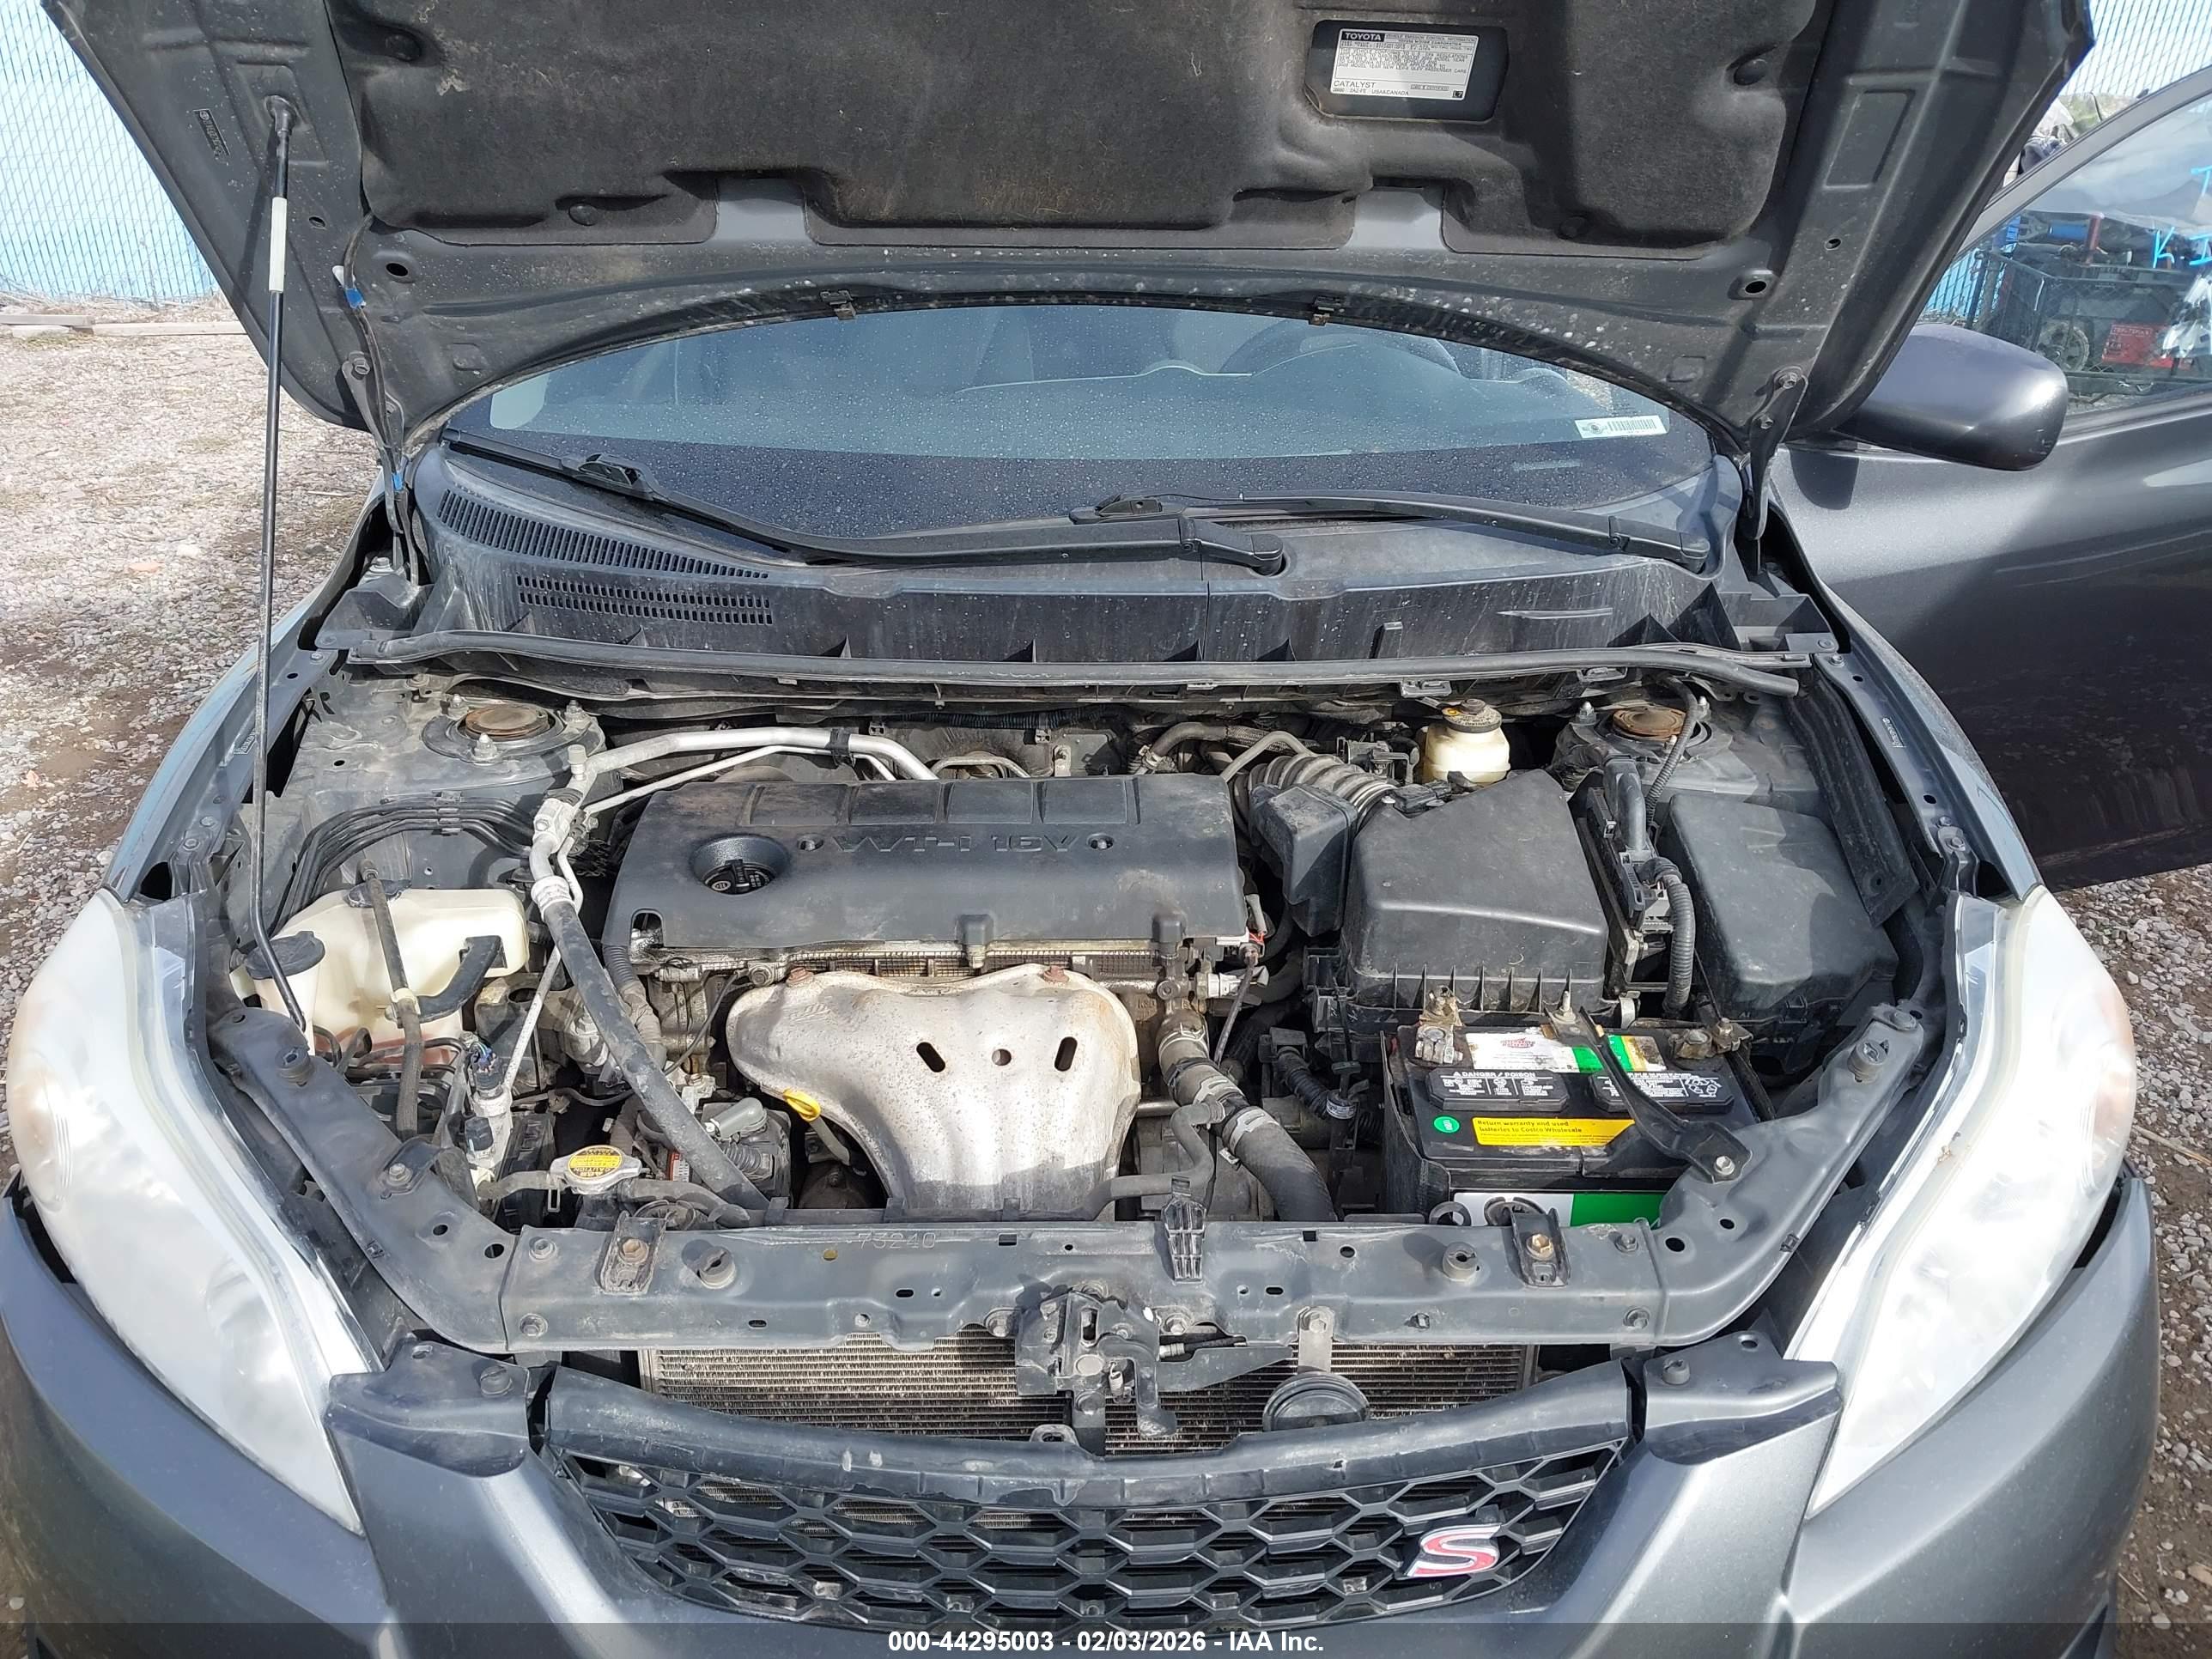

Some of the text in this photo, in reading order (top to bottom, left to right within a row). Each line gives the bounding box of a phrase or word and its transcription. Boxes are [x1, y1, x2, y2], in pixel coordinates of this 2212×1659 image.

[1345, 33, 1382, 41] TOYOTA
[1334, 80, 1376, 88] CATALYST
[991, 835, 1079, 852] 16V
[1404, 1522, 1502, 1577] S
